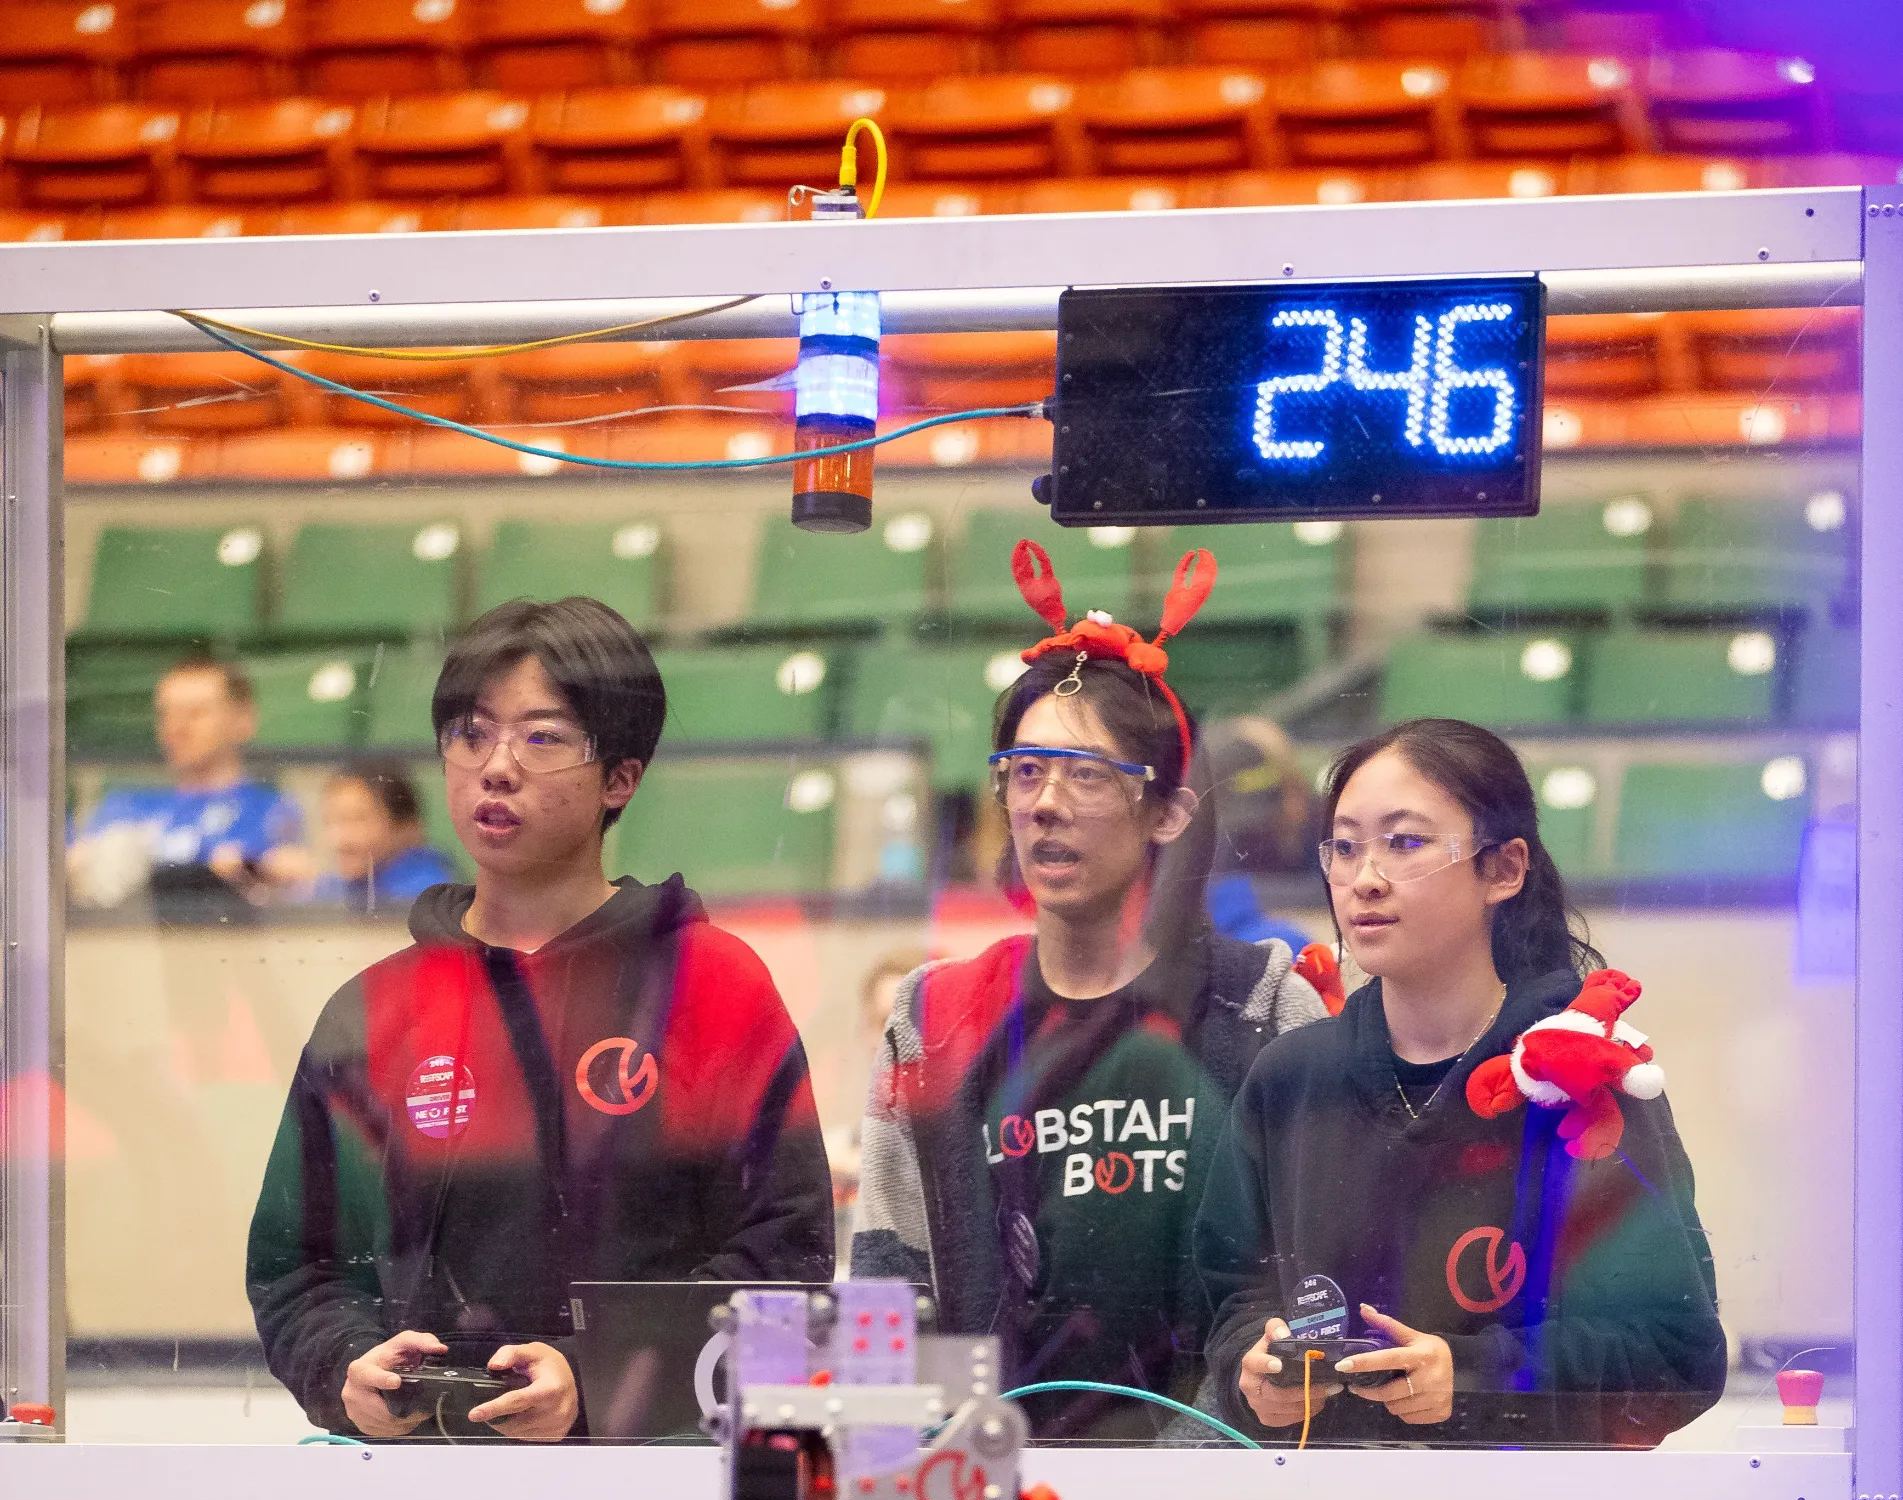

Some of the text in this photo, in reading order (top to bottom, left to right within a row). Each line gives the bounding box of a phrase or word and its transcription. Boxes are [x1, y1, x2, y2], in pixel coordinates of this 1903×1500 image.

[1252, 303, 1516, 460] 246
[982, 1097, 1196, 1165] LOBSTAH
[1063, 1149, 1188, 1197] BOTS
